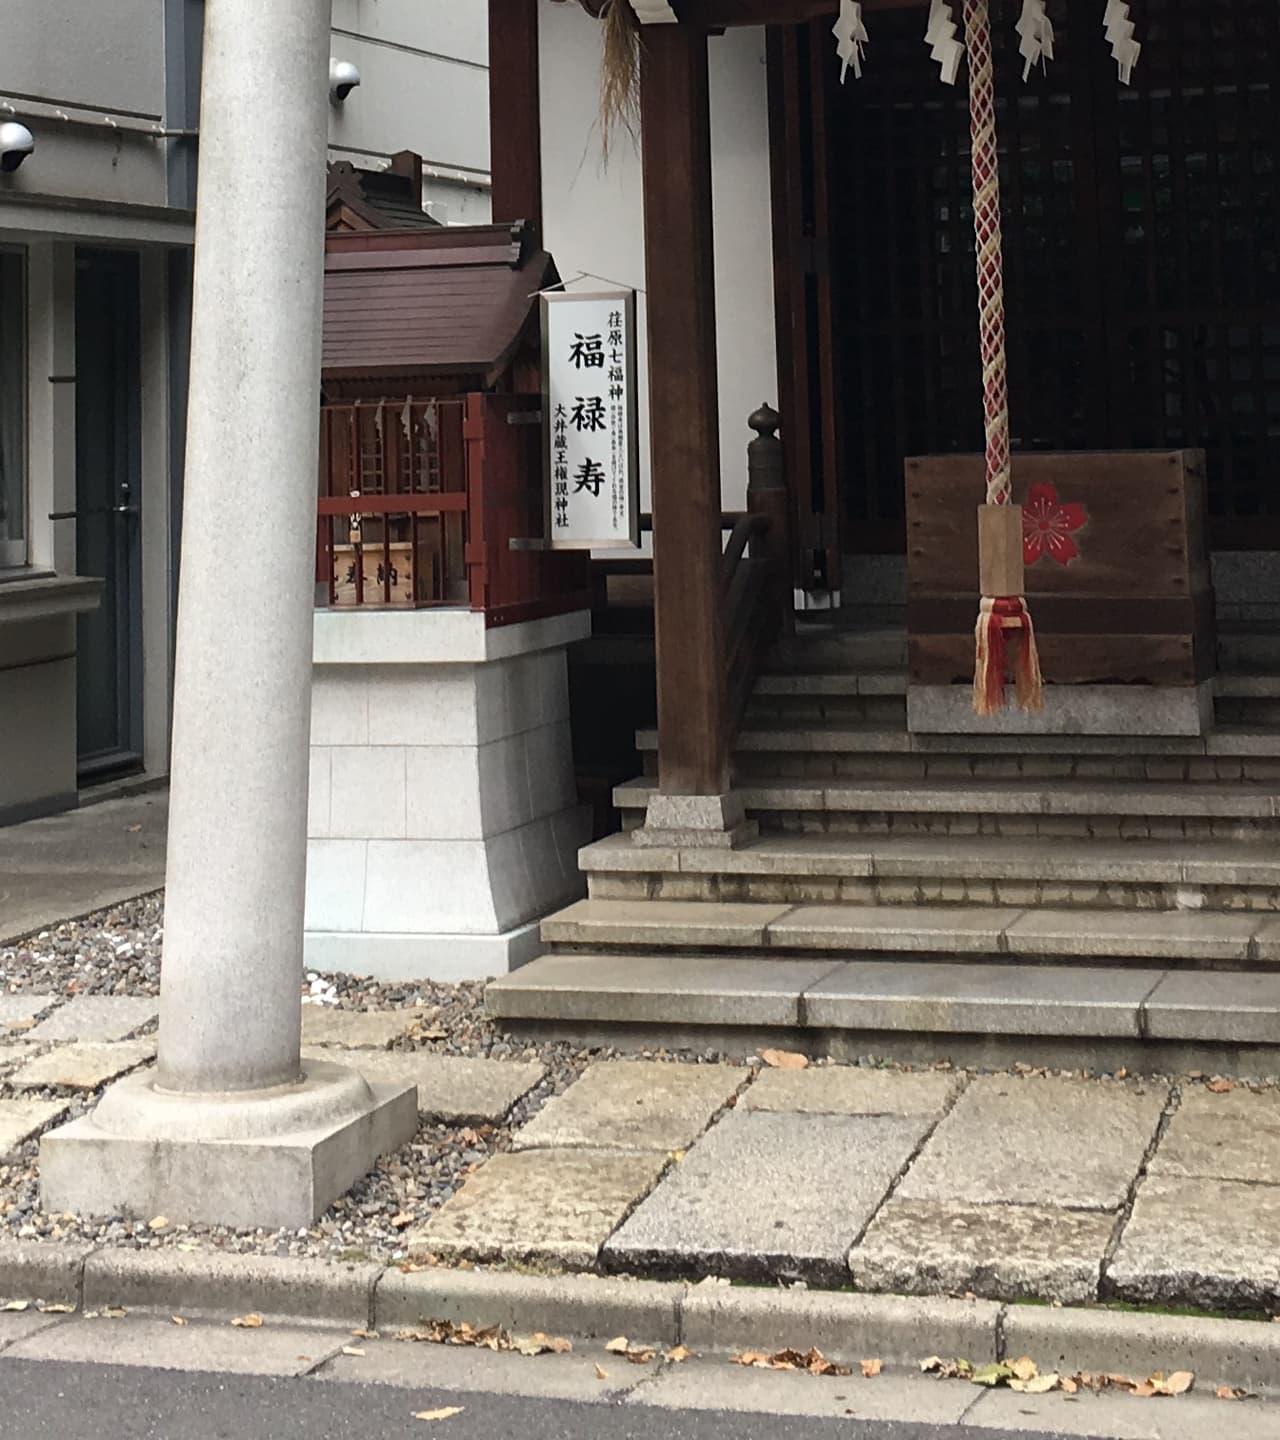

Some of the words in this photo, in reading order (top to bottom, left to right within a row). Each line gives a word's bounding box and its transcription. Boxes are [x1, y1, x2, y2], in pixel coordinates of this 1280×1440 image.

[569, 332, 607, 498] 福禄寿
[607, 311, 624, 400] 荏原七福神
[554, 403, 569, 528] 大井蔵王権現神社
